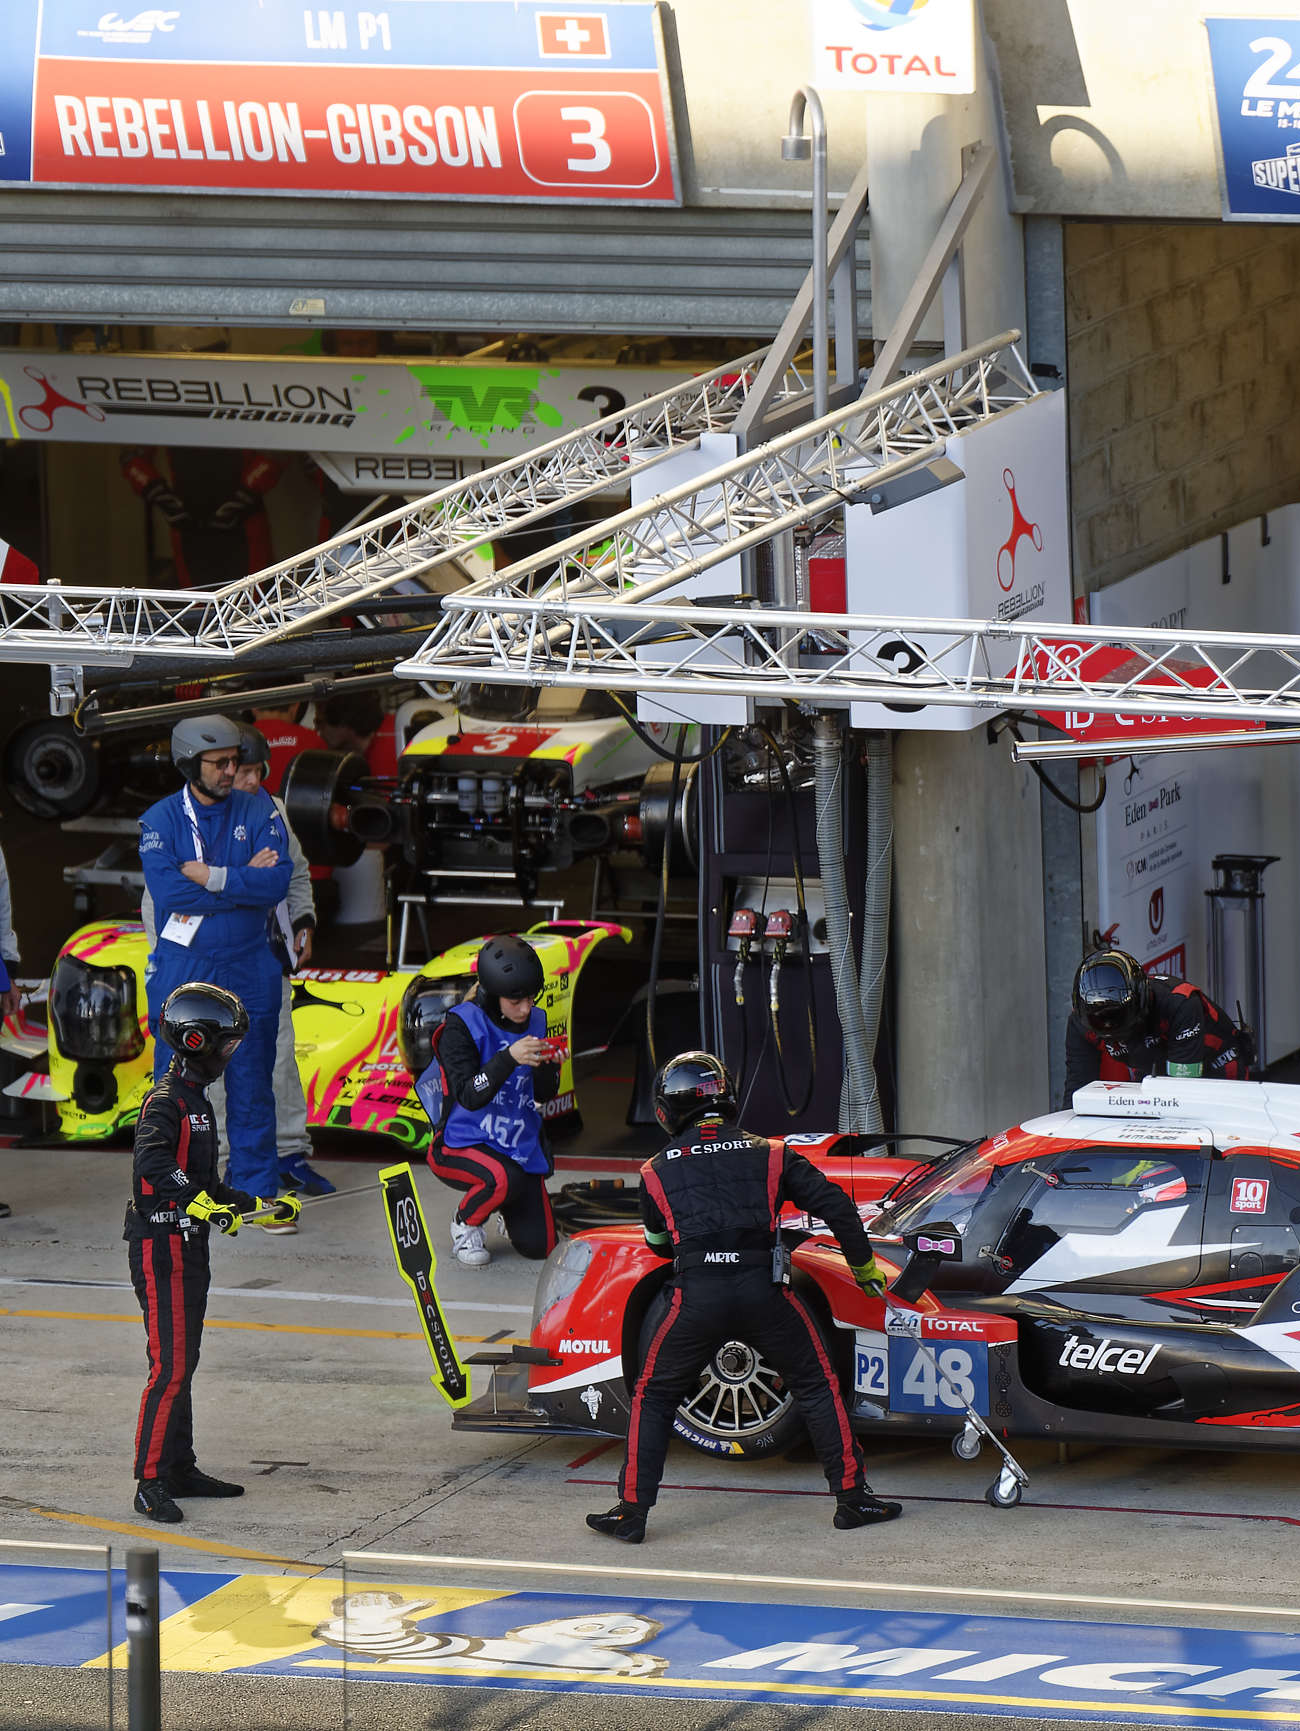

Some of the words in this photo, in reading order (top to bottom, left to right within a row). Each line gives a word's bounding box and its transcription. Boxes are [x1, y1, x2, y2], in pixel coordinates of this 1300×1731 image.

[303, 10, 348, 49] LM
[361, 11, 392, 51] P1
[825, 46, 956, 77] TOTAL
[1241, 99, 1275, 117] LE
[54, 95, 502, 168] REBELLION-GIBSON
[560, 105, 612, 172] 3
[77, 376, 353, 412] REBELLION
[577, 385, 626, 445] 3
[472, 733, 518, 755] 3
[1124, 803, 1147, 827] Eden
[1159, 781, 1181, 810] Park
[1108, 1095, 1135, 1106] Eden
[1153, 1096, 1180, 1108] Park
[666, 1144, 702, 1160] IDEC
[702, 1139, 754, 1155] SPORT
[1234, 1200, 1262, 1210] sport
[1236, 1181, 1263, 1198] 10
[395, 1196, 422, 1249] 48
[415, 1271, 436, 1319] IDEC
[431, 1321, 460, 1388] SPORT
[924, 1318, 985, 1333] TOTAL
[558, 1339, 611, 1355] MOTUL
[1058, 1334, 1163, 1376] telcel
[857, 1351, 886, 1390] P2
[902, 1346, 976, 1409] 48
